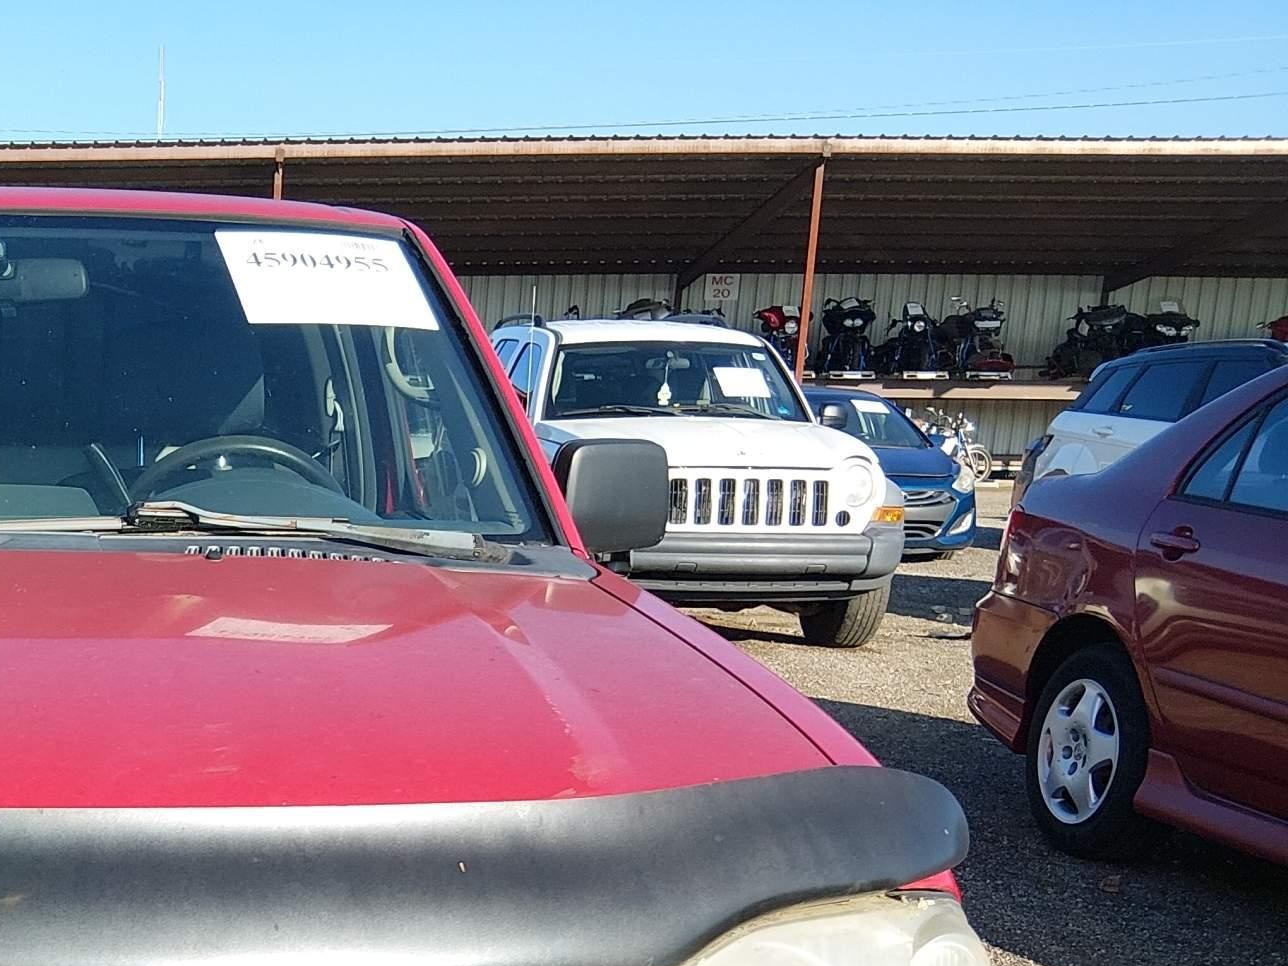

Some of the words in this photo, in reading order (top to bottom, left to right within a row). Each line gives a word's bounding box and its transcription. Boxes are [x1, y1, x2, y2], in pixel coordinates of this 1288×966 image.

[246, 251, 390, 273] 45904955
[712, 275, 734, 286] MC
[713, 288, 731, 299] 20
